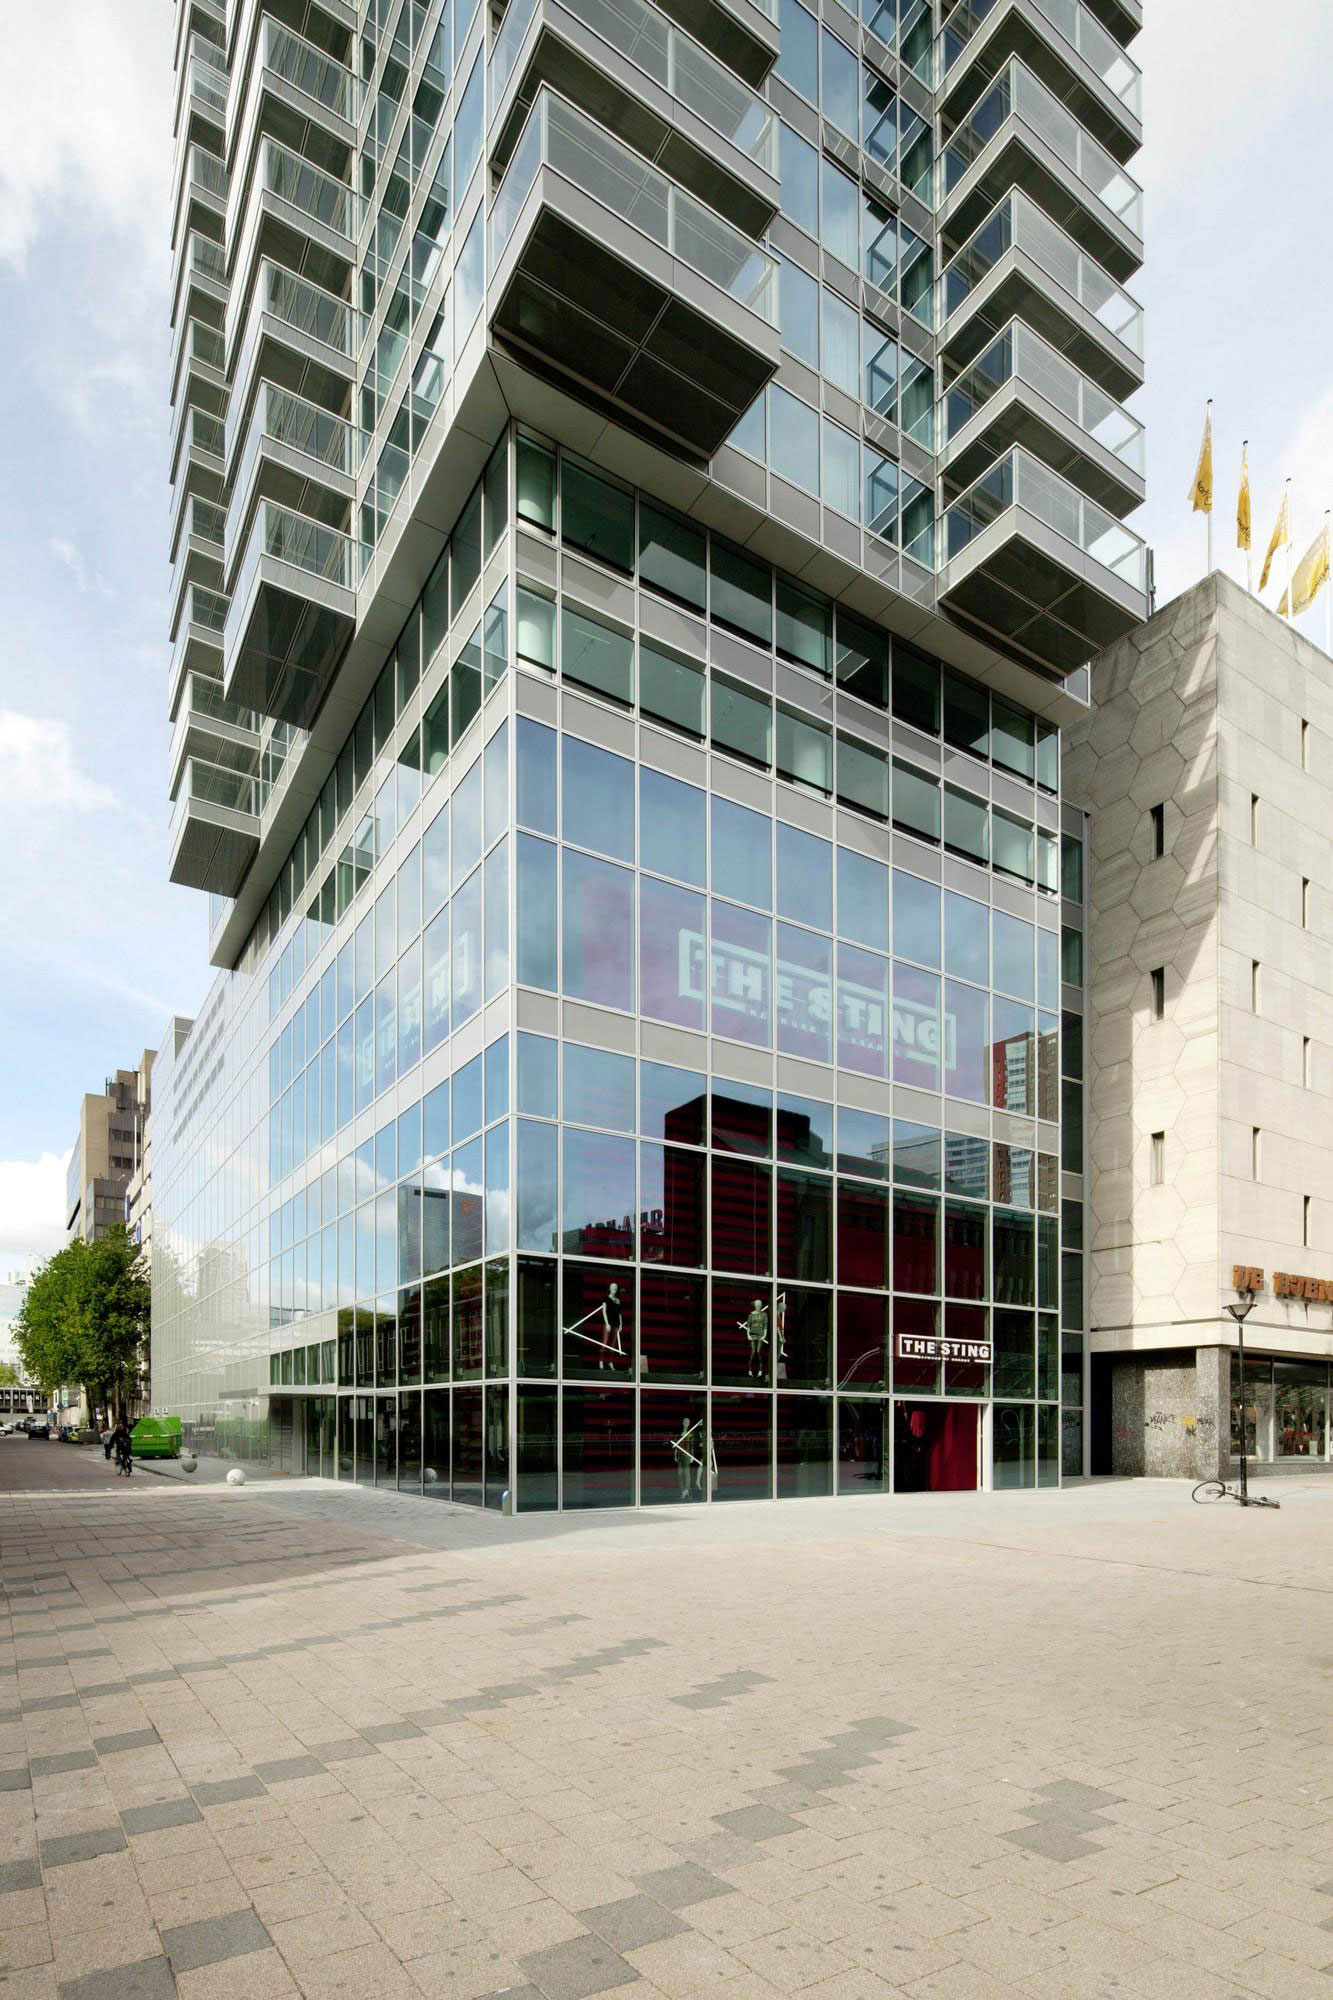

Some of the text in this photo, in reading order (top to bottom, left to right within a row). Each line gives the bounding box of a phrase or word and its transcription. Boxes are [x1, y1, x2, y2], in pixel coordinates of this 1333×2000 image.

[695, 948, 943, 1054] THE STING
[904, 1339, 990, 1357] THE STING
